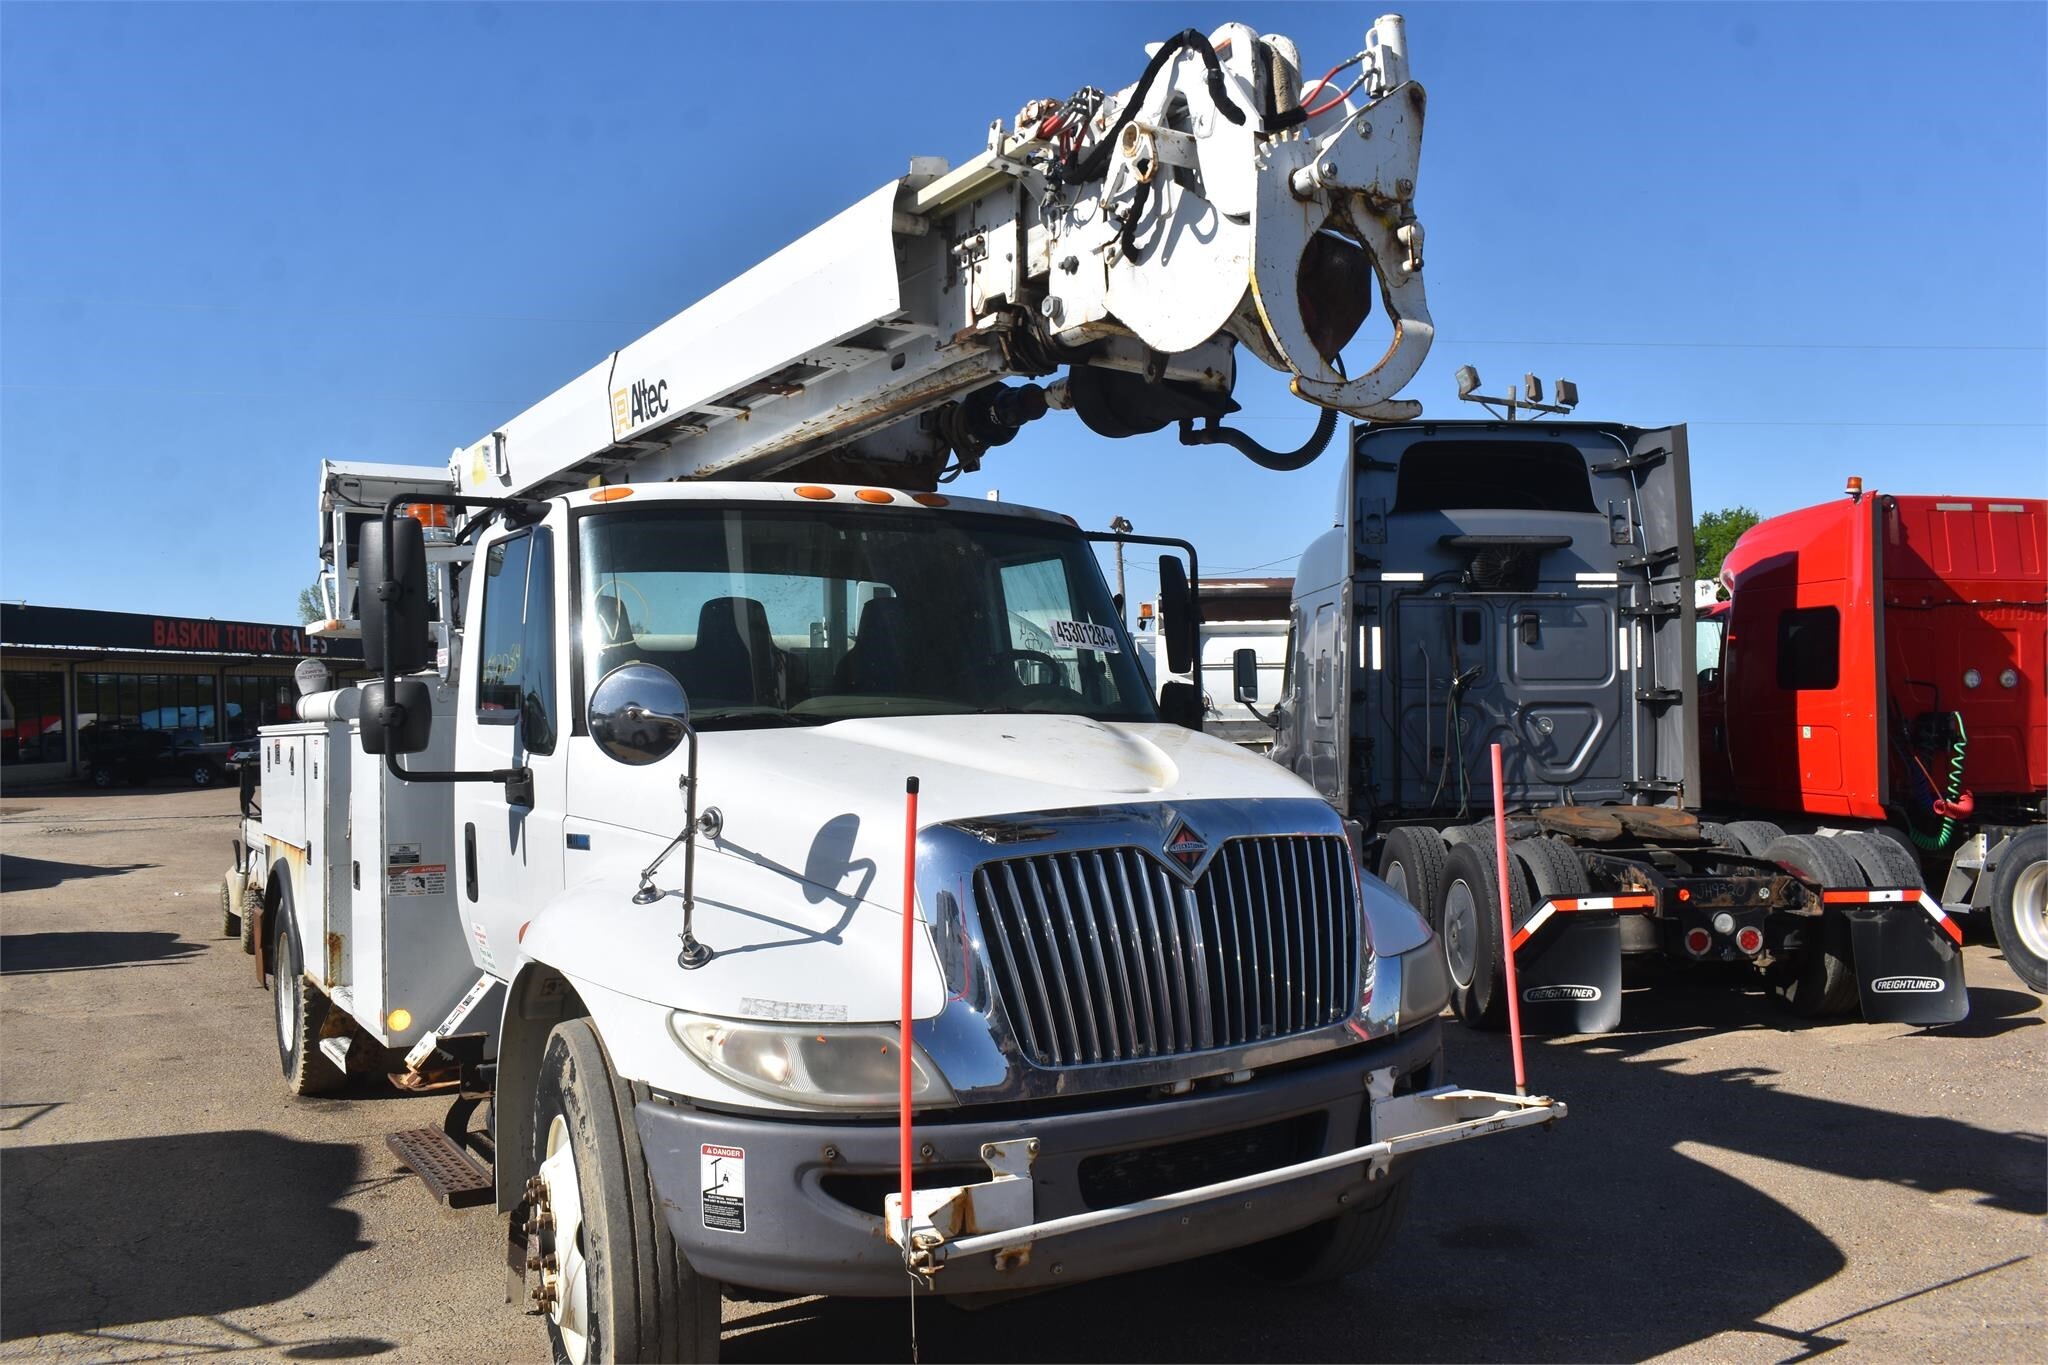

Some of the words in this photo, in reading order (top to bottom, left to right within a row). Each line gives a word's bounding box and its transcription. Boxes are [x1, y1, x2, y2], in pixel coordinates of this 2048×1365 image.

[631, 378, 669, 427] Altec
[153, 619, 219, 648] BASKIN
[225, 624, 276, 651] TRUCK
[282, 629, 327, 655] SALES
[1877, 979, 1937, 990] FREIGHTLINER
[1529, 988, 1593, 999] FREIGHTLINER
[712, 1148, 741, 1157] DANGER
